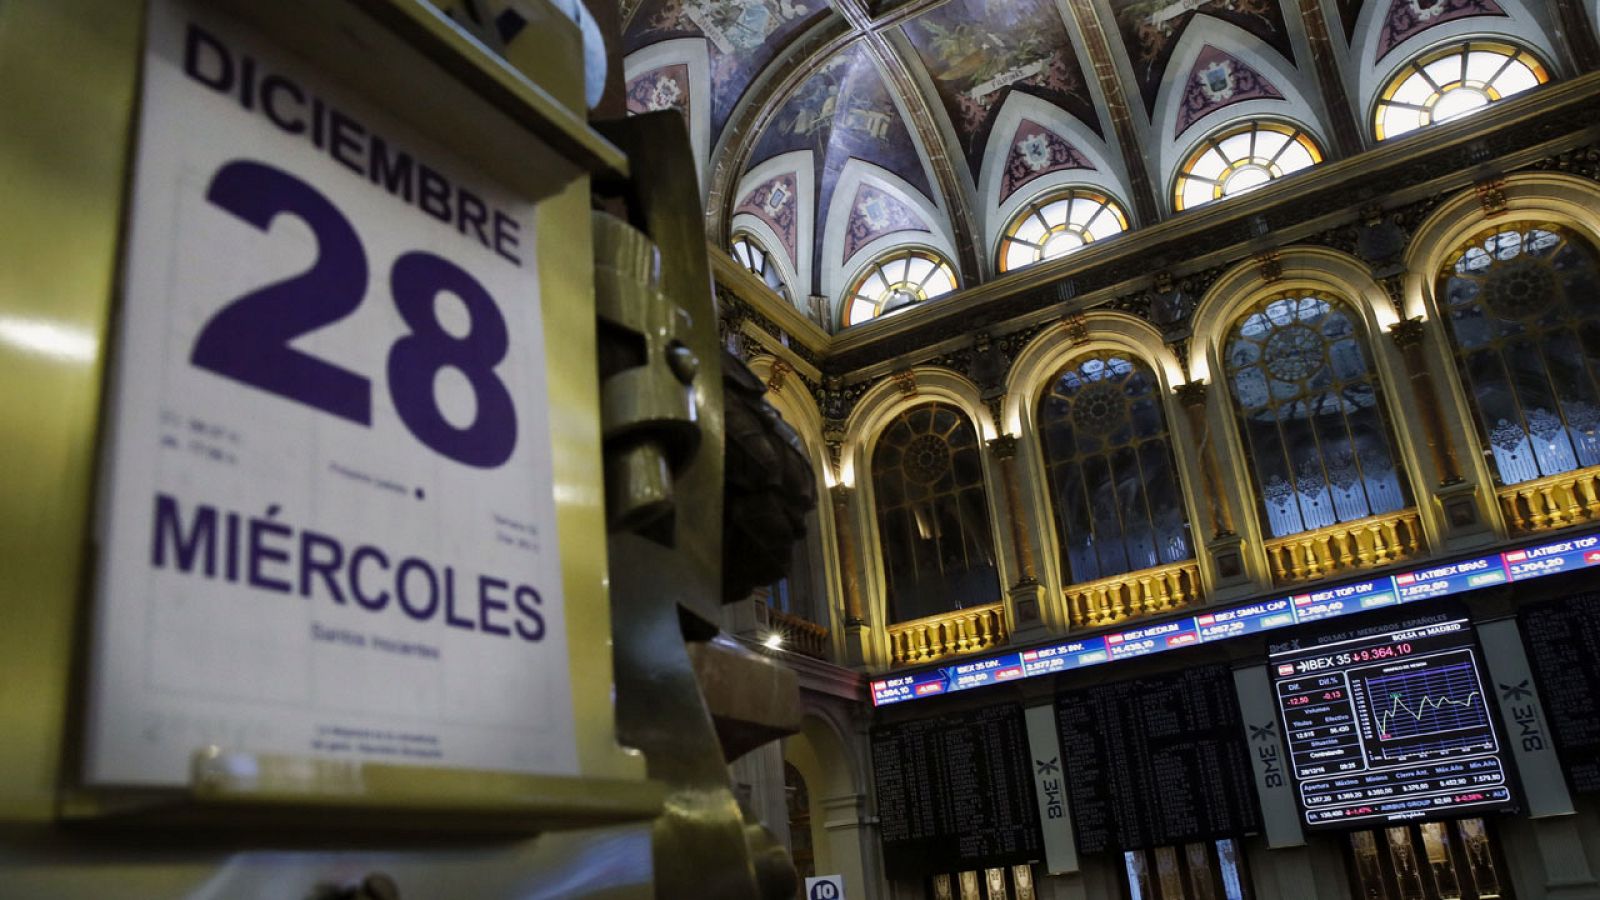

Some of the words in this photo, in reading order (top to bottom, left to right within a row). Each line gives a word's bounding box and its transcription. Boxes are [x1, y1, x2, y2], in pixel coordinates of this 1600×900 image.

[183, 23, 522, 267] DICIEMBRE
[190, 159, 518, 469] 28
[1527, 543, 1574, 559] LATIBEX
[1573, 537, 1598, 549] TOP
[151, 492, 547, 642] MIÉRCOLES
[1415, 565, 1458, 581] LATIBEX
[1457, 559, 1488, 573] BRAS
[1311, 590, 1335, 602] IBEX
[1334, 586, 1355, 597] TOP
[1355, 583, 1373, 594] DIV
[1214, 611, 1236, 622] IBEX
[1236, 605, 1267, 617] SMALL
[1266, 600, 1287, 611] CAP
[1124, 631, 1144, 641] IBEX
[1144, 623, 1180, 636] MEDIUM
[1318, 632, 1346, 643] BOLSAS
[1357, 623, 1400, 636] MERCADOS
[1403, 613, 1448, 629] ESPAÑOLES
[1392, 630, 1418, 641] BOLSA
[1427, 623, 1461, 635] MADRID
[1038, 648, 1057, 658] IBEX
[1305, 657, 1335, 671] IBEX
[1336, 653, 1351, 666] 35
[1361, 643, 1411, 662] 9.364,10
[957, 664, 975, 674] IBEX
[887, 678, 904, 687] IBEX
[904, 676, 914, 684] 35
[1513, 704, 1544, 752] BME
[1258, 745, 1282, 788] BME
[1044, 779, 1066, 819] BME
[816, 883, 835, 900] 10
